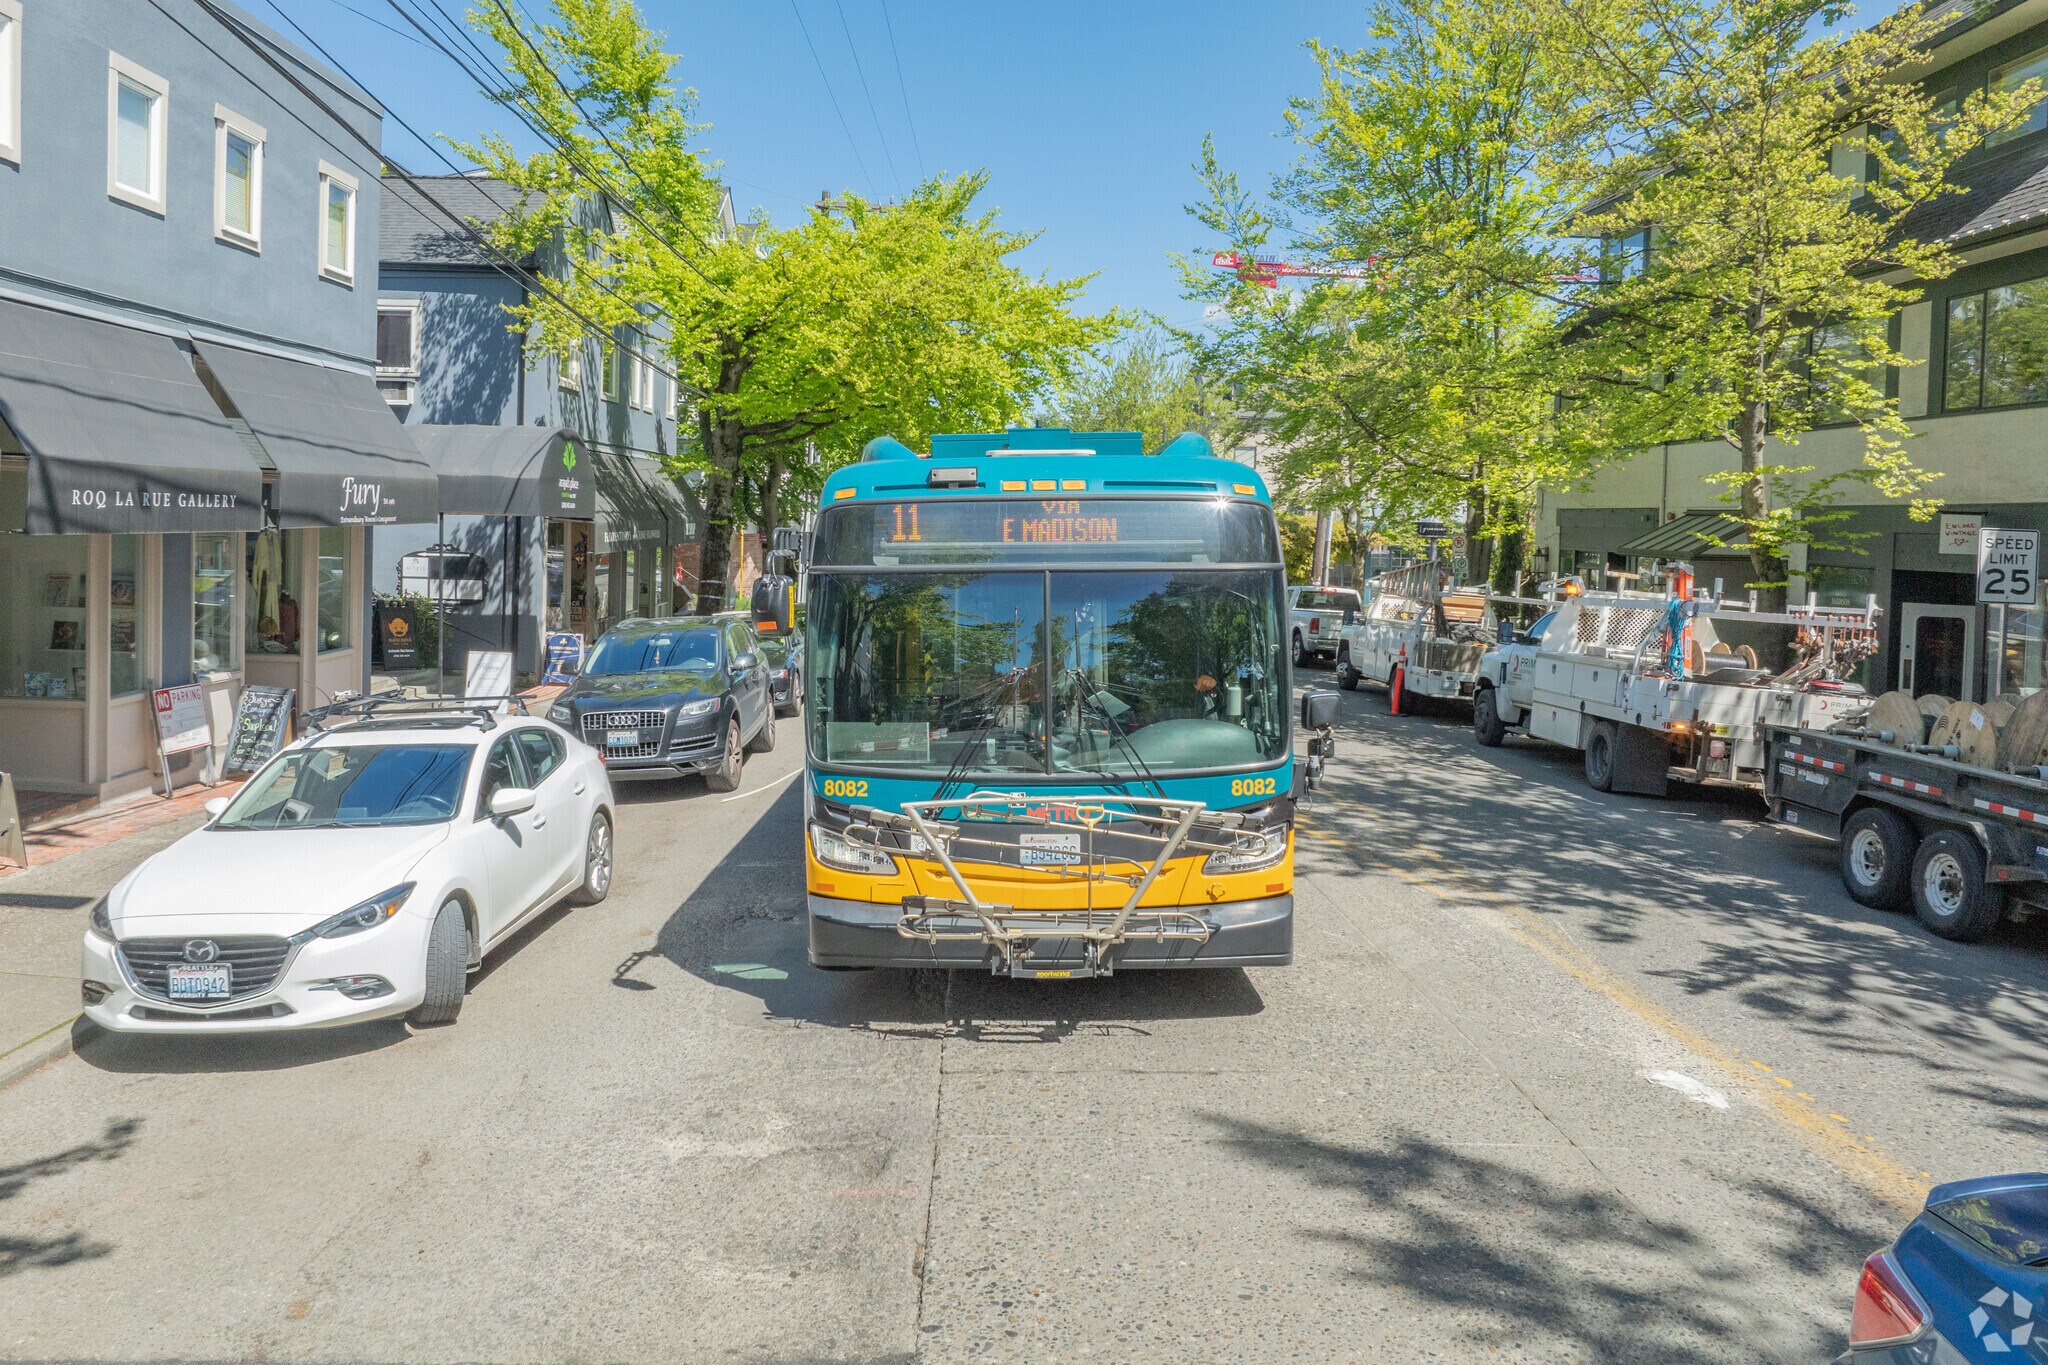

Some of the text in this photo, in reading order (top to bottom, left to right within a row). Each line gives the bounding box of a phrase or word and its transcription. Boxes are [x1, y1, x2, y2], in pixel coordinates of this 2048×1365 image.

[72, 490, 236, 509] ROQ LA RUE GALLERY
[340, 477, 380, 515] Fury
[1041, 500, 1080, 514] VIA
[893, 504, 922, 541] 11
[1003, 518, 1117, 542] E MADISON
[1985, 538, 2034, 550] SPEED
[1989, 553, 2028, 565] LIMIT
[1984, 568, 2030, 595] 25
[1520, 657, 1537, 669] PRIM
[157, 688, 202, 709] NO PARKING
[1830, 701, 1852, 709] PRIM
[242, 718, 277, 734] Shop local
[824, 780, 868, 797] 8082
[1231, 778, 1276, 796] 8082
[1026, 806, 1091, 821] METRO
